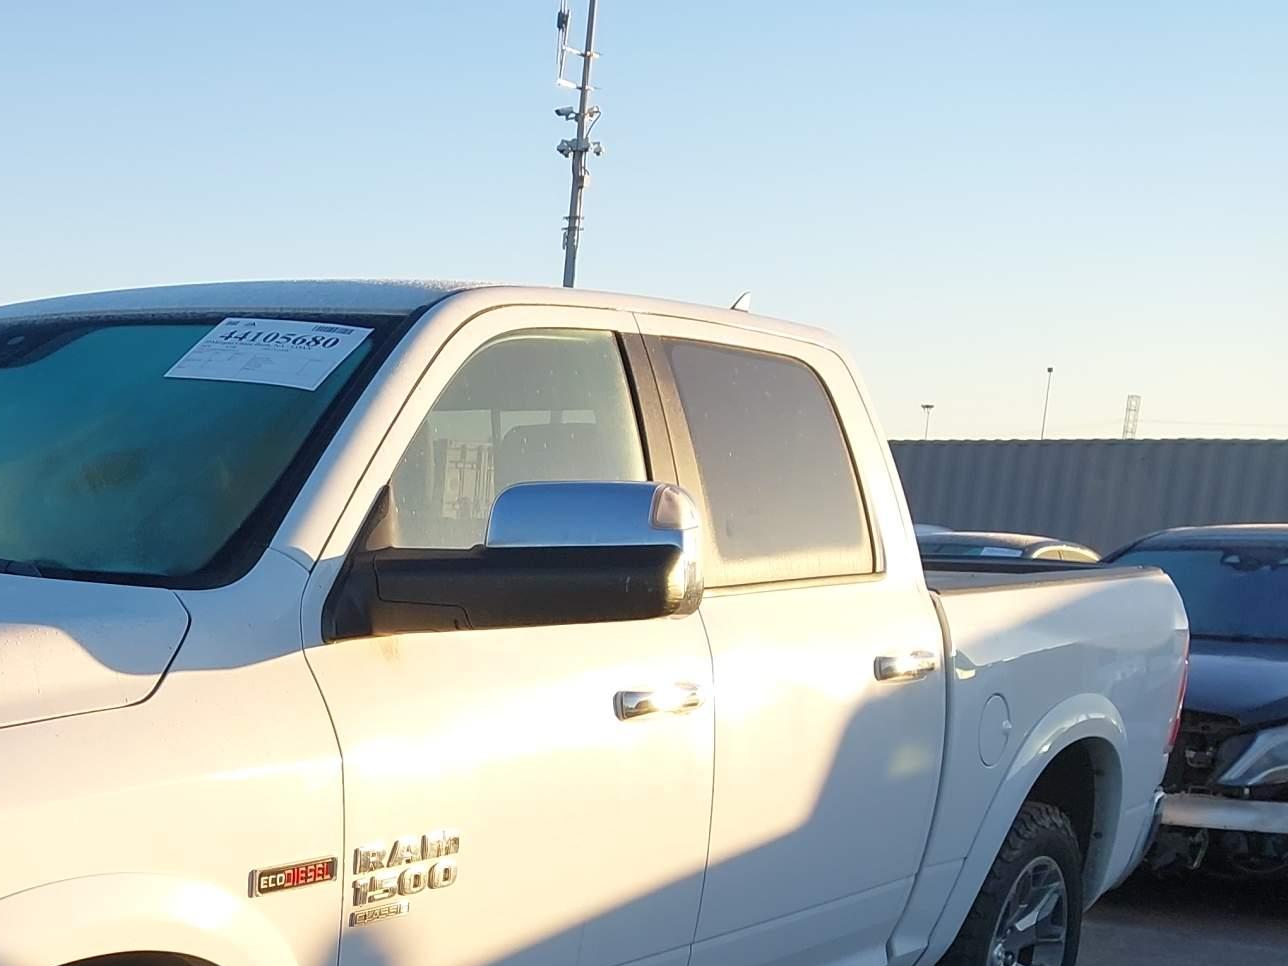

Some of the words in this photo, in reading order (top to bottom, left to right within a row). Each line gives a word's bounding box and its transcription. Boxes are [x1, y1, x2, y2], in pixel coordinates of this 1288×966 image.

[220, 330, 340, 349] 44105680
[353, 830, 460, 875] RAM
[260, 863, 331, 890] ECODIESEL
[352, 857, 458, 906] 1500
